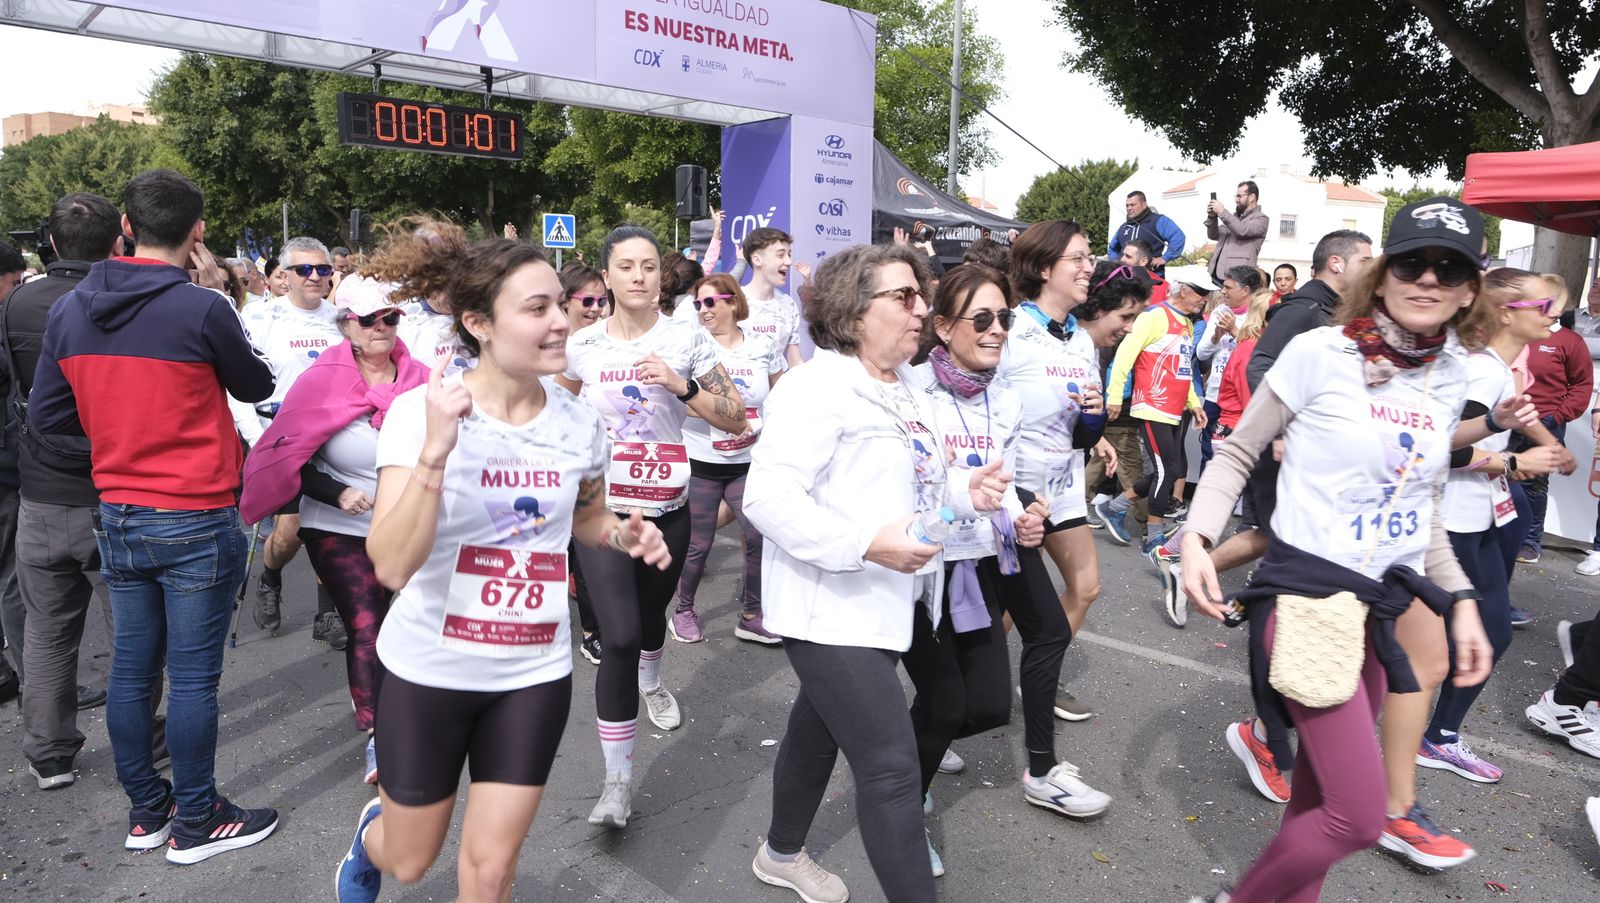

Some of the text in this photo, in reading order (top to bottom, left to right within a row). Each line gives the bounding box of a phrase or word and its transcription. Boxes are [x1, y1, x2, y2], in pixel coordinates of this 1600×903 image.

[625, 10, 794, 62] ES NUESTRA META.
[375, 101, 516, 152] 00:01:01
[817, 149, 852, 160] HYUNDAI
[826, 175, 854, 186] cajamar
[826, 227, 851, 237] vithas
[289, 339, 329, 348] MUJER
[600, 368, 646, 383] MUJE
[727, 368, 754, 377] UJER
[1045, 366, 1086, 378] MUJER
[1370, 403, 1436, 431] MUJER
[944, 434, 996, 450] MUJER
[480, 468, 561, 488] MUJER
[629, 462, 672, 480] 679
[1350, 510, 1418, 541] 1163
[474, 556, 504, 569] MUJER
[480, 579, 545, 610] 678
